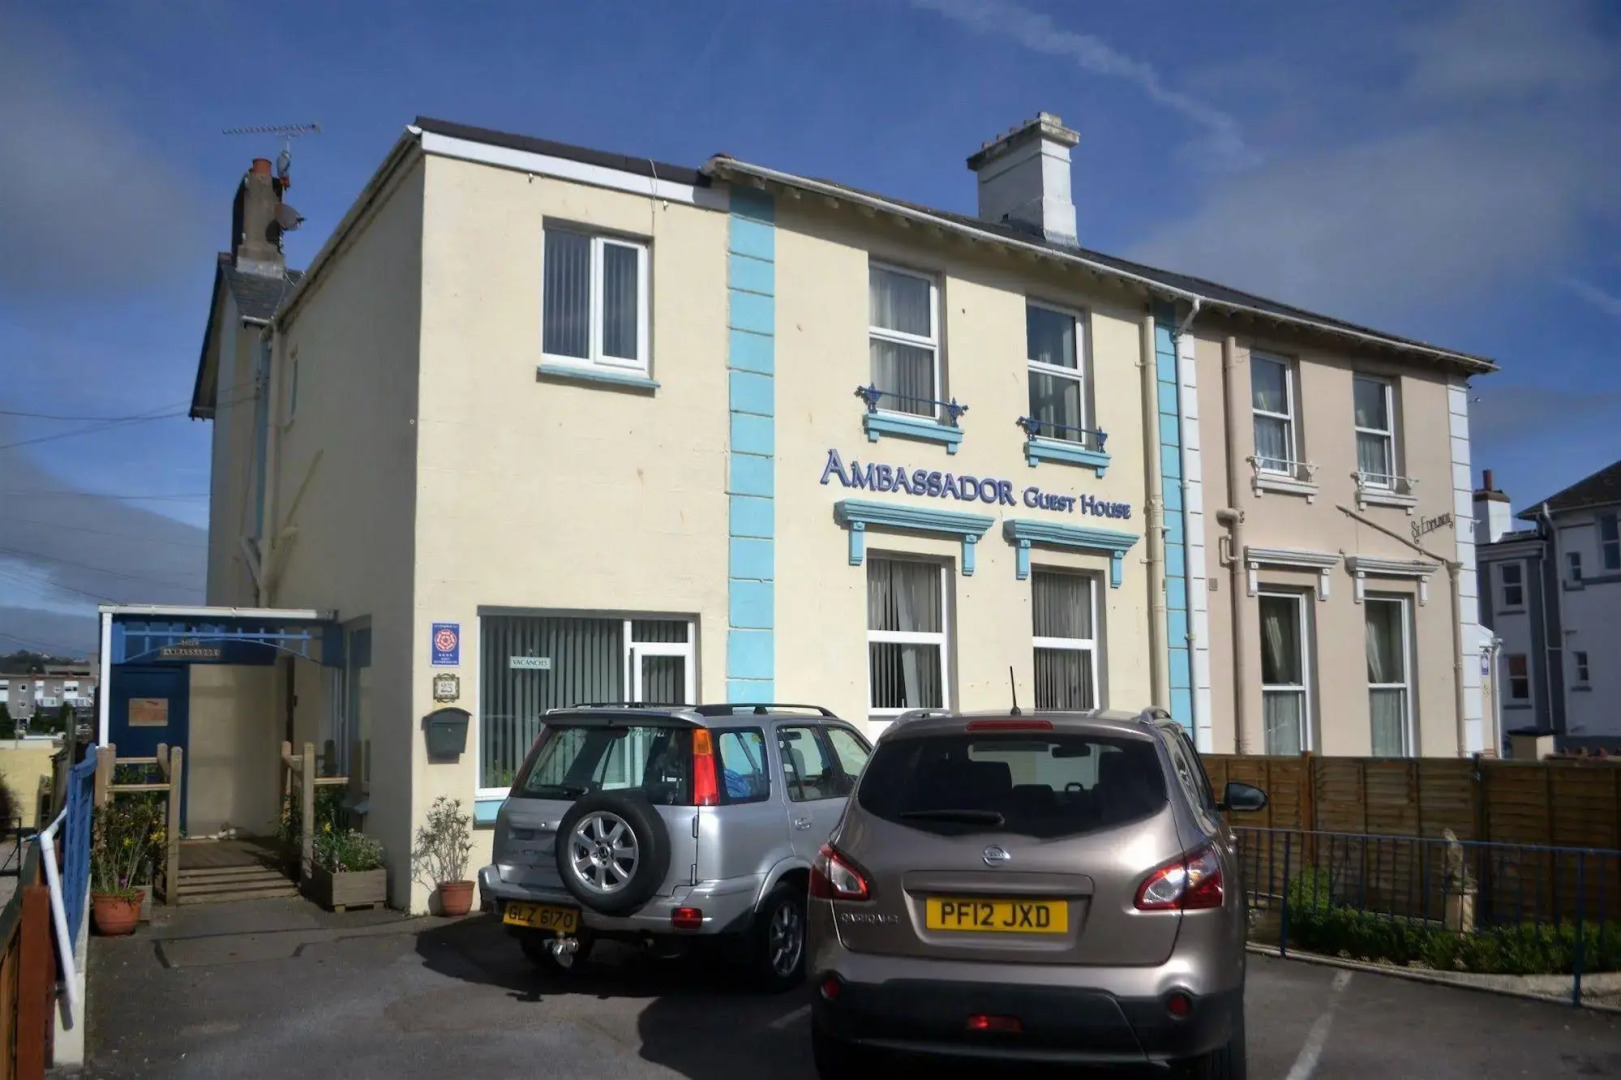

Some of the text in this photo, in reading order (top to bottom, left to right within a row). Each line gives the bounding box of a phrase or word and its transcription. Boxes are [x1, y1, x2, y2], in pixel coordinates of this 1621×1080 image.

[820, 448, 1017, 506] AMBASSADOR
[508, 905, 574, 928] GLZ 6170
[940, 902, 1050, 928] PF12 JXD
